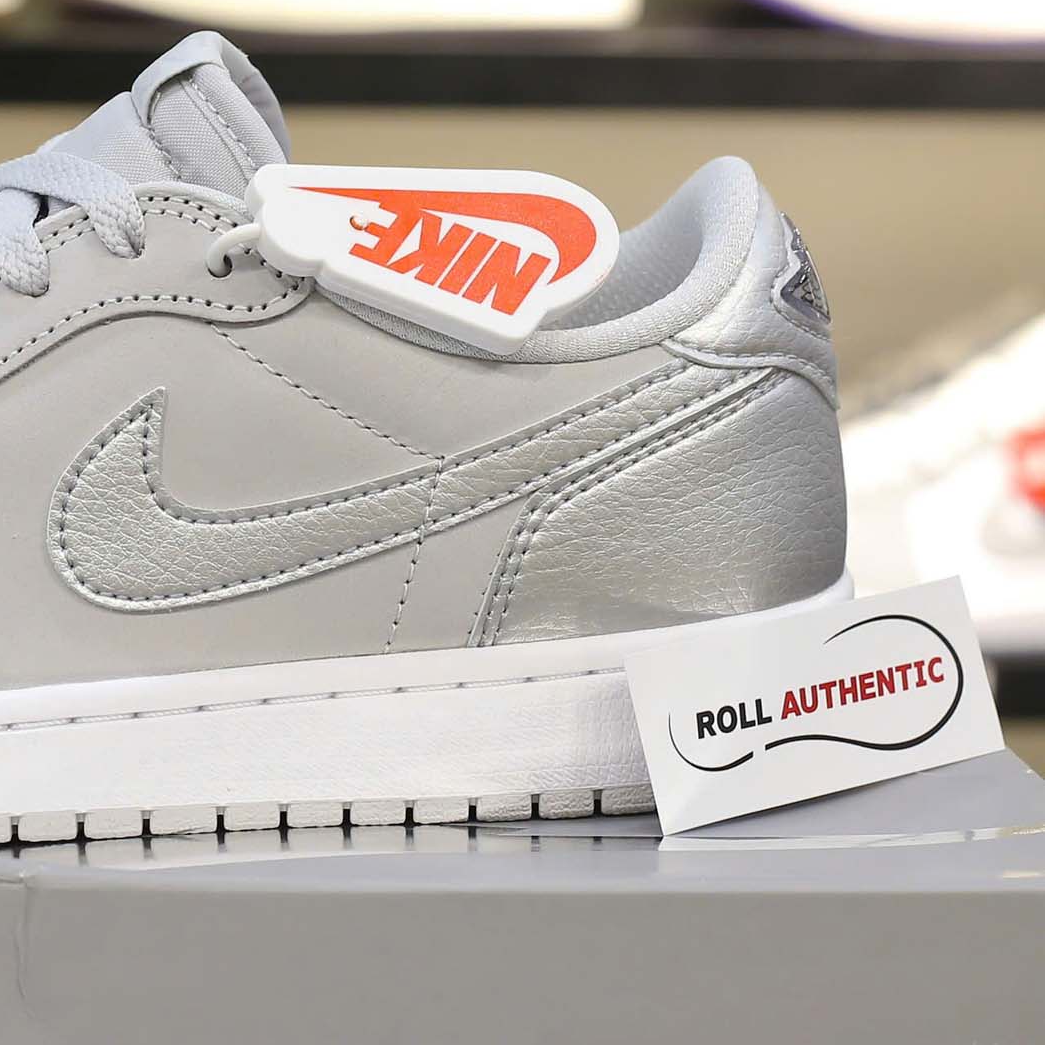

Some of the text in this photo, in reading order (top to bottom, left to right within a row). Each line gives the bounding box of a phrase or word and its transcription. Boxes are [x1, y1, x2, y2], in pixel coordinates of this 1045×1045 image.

[349, 201, 552, 315] NIKE
[696, 657, 945, 739] ROLL AUTHENTIC
